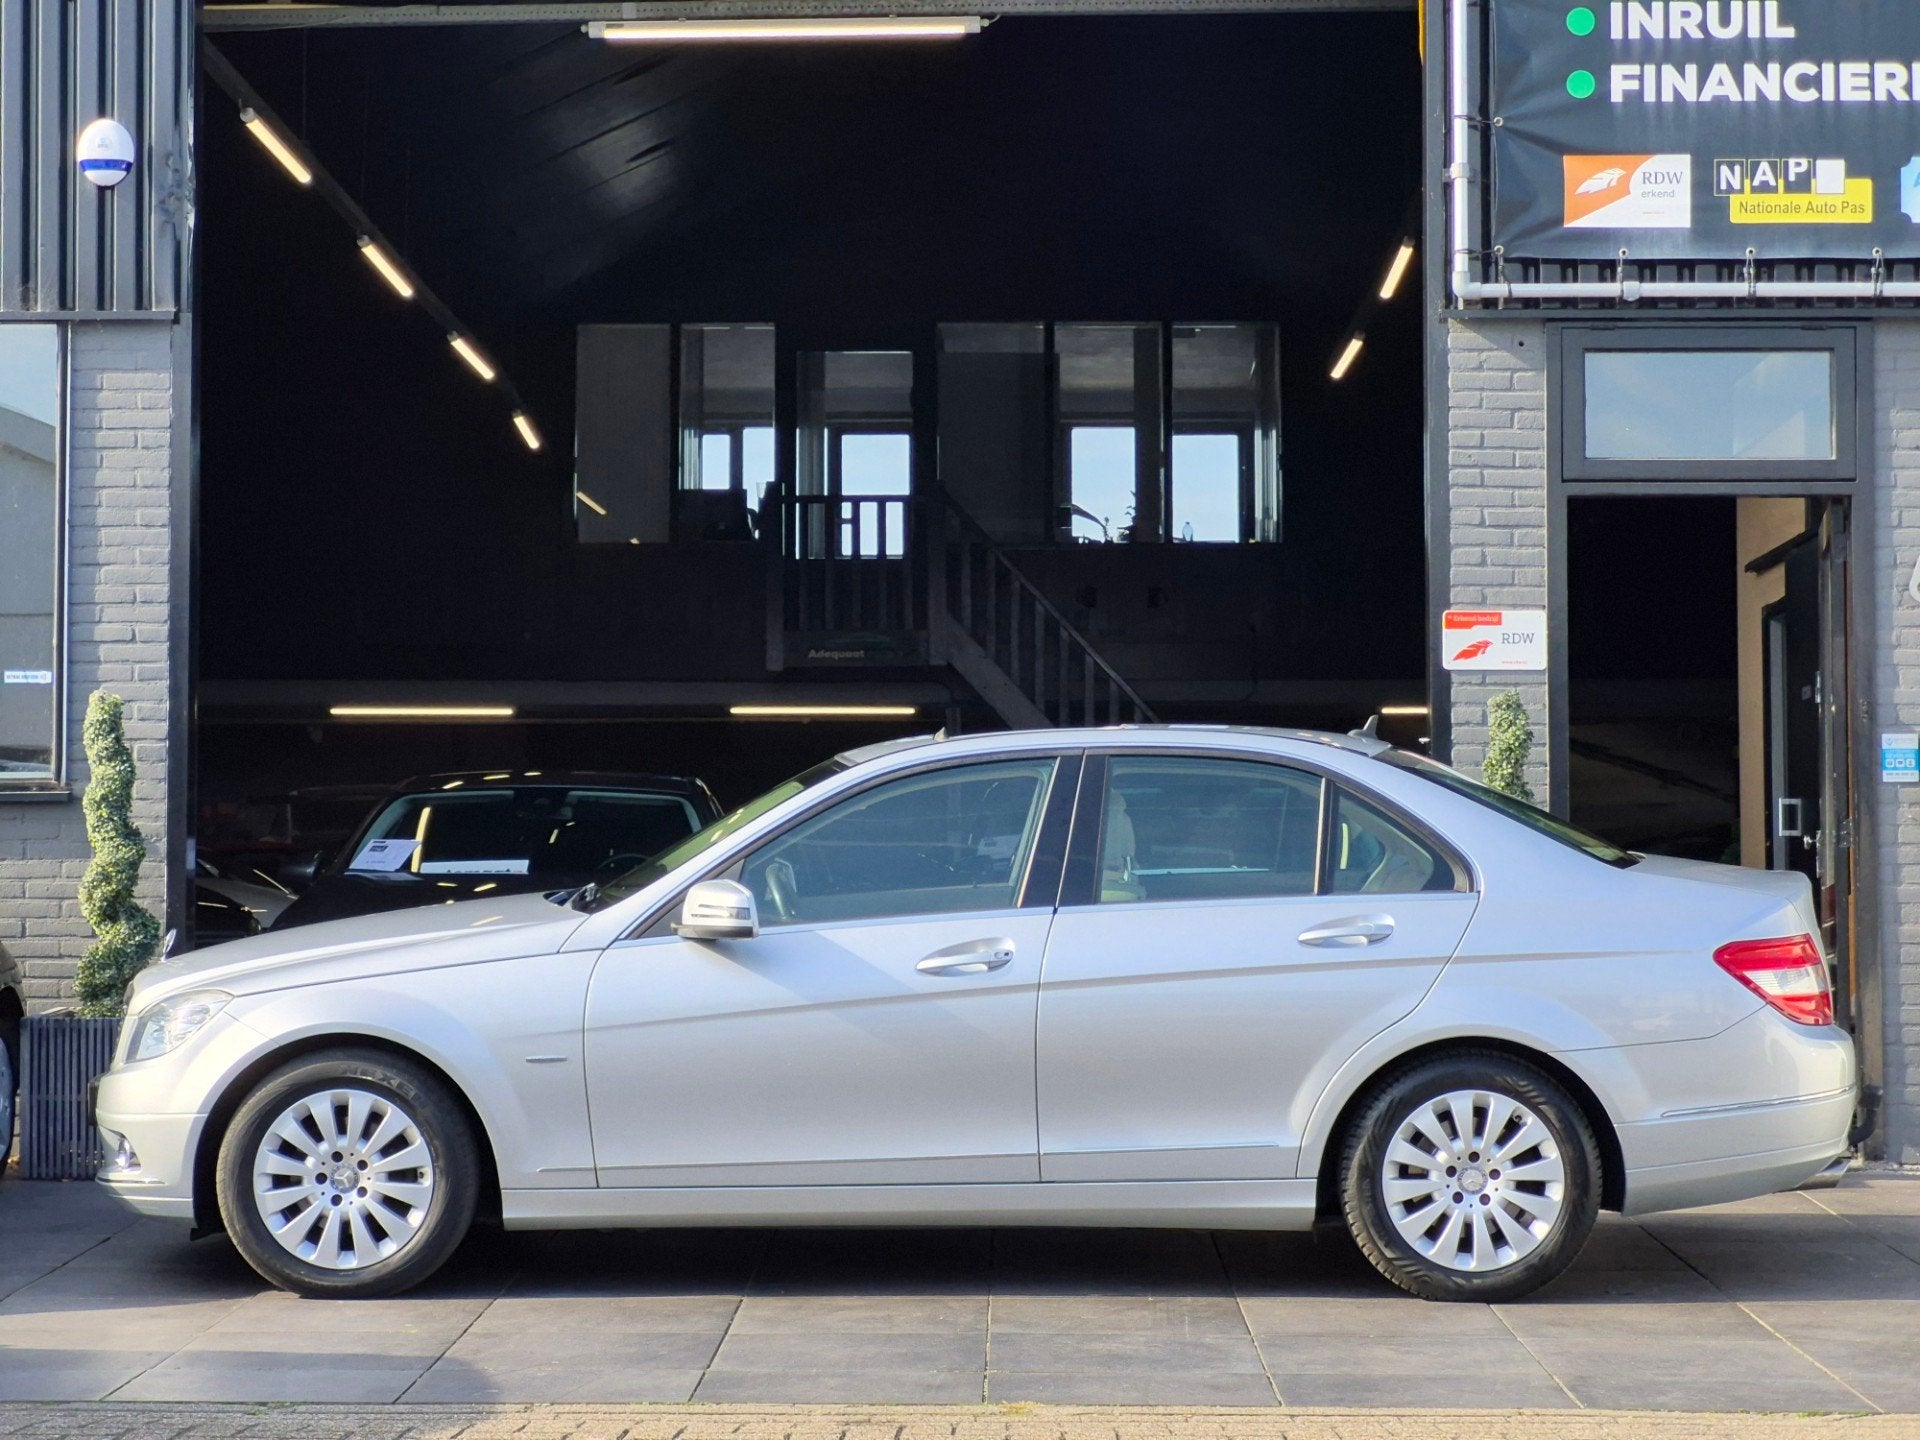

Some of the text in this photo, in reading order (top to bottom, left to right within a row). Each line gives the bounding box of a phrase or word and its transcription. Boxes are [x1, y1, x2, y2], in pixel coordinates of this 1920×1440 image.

[1609, 0, 1796, 40] INRUIL
[1641, 171, 1683, 185] RDW
[1718, 157, 1810, 191] NAP
[1640, 188, 1676, 199] erkend
[1738, 200, 1866, 214] Nationale Auto Pas
[1501, 632, 1535, 645] RDW
